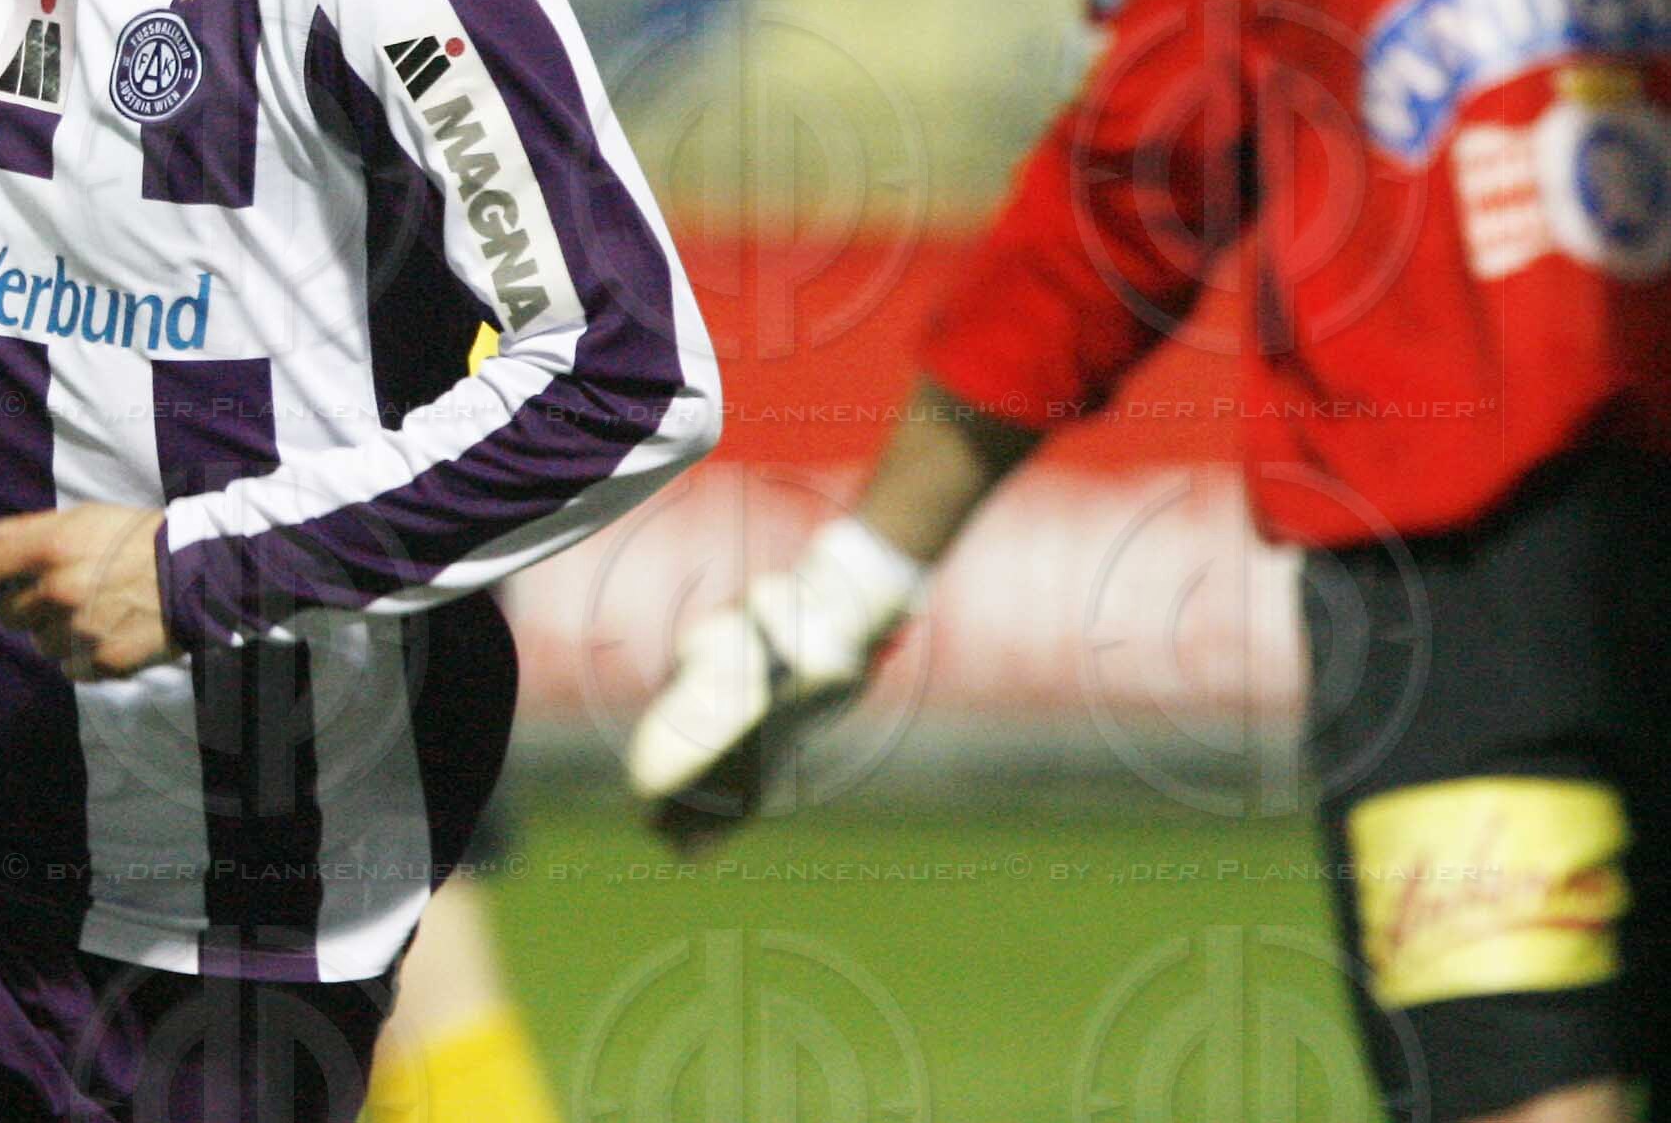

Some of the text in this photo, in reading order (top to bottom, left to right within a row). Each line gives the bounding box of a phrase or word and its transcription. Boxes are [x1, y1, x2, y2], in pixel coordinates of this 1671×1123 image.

[119, 79, 181, 114] AUSTRIA WIEN
[422, 94, 551, 333] MAGNA
